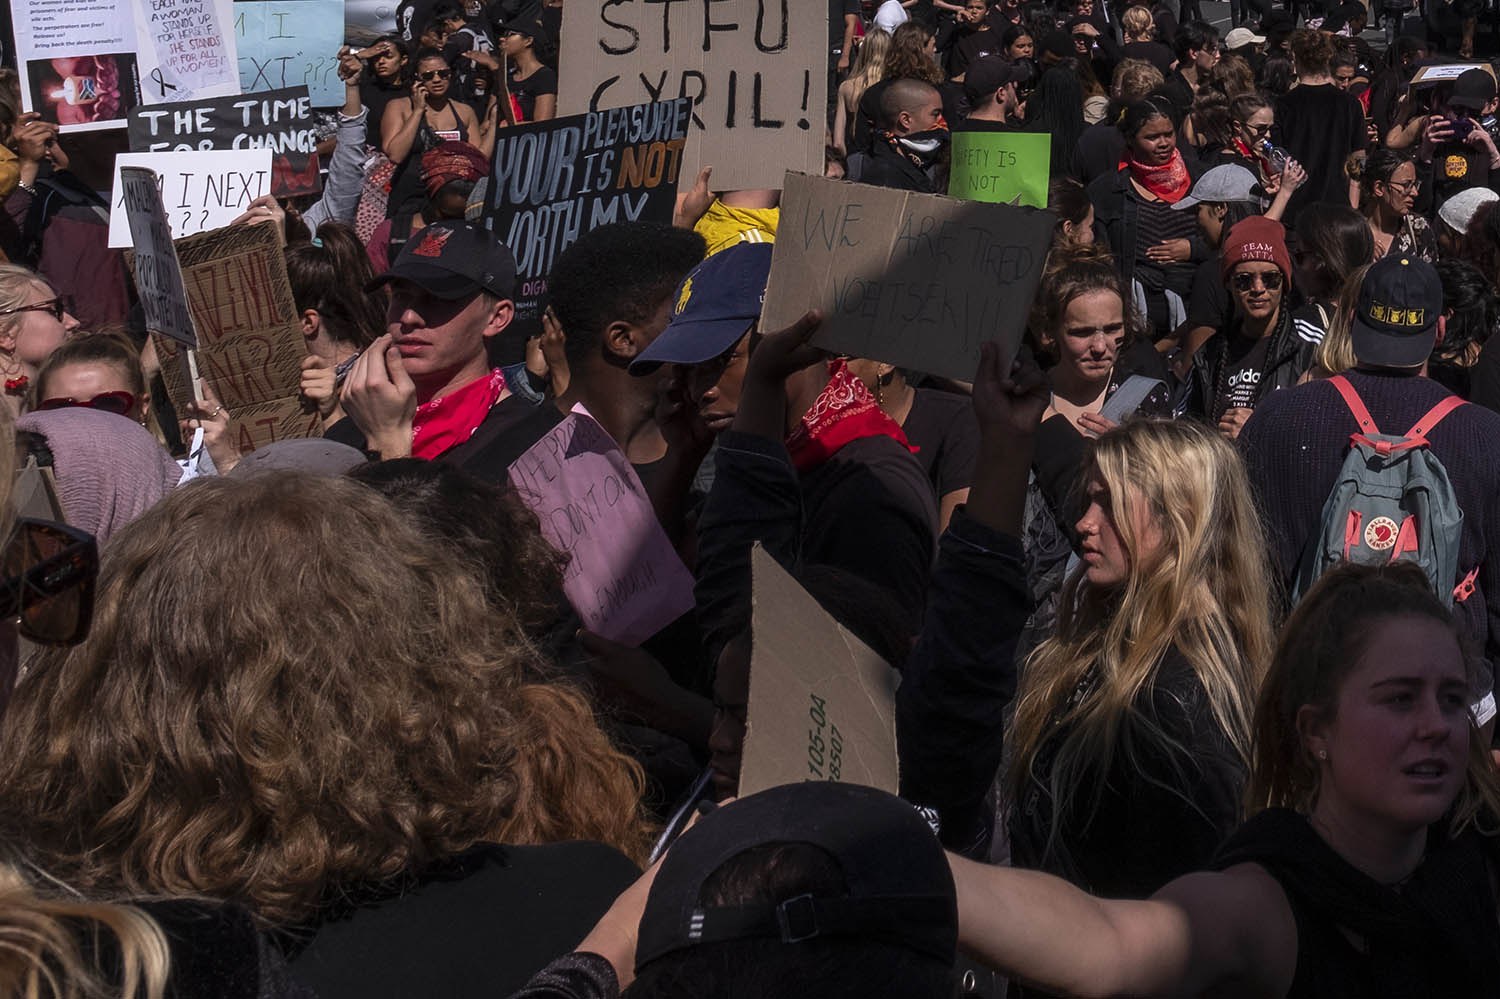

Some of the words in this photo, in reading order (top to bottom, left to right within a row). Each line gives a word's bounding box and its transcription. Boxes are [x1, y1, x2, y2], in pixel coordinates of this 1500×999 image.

[160, 3, 204, 21] WOMAN
[162, 17, 194, 33] STANDS
[198, 13, 212, 25] UP
[157, 32, 175, 43] FOR
[169, 41, 186, 55] SHE
[189, 35, 221, 51] STANDS
[166, 56, 178, 68] UP
[180, 53, 197, 63] FOR
[200, 49, 218, 58] ALL
[589, 69, 811, 131] CYRIL!
[138, 107, 216, 136] THE
[232, 96, 311, 128] TIME
[232, 127, 317, 154] CHANGE
[495, 126, 582, 209] YOUR
[582, 97, 688, 151] PLEASURE
[998, 150, 1017, 167] IS
[577, 149, 615, 194] IS
[616, 138, 688, 190] NOT
[177, 173, 194, 208] I
[203, 170, 268, 208] NEXT
[969, 173, 1000, 192] NOT
[804, 201, 863, 251] WE
[891, 214, 961, 264] ARE
[1241, 250, 1274, 261] PATTA
[1242, 242, 1273, 252] TEAM
